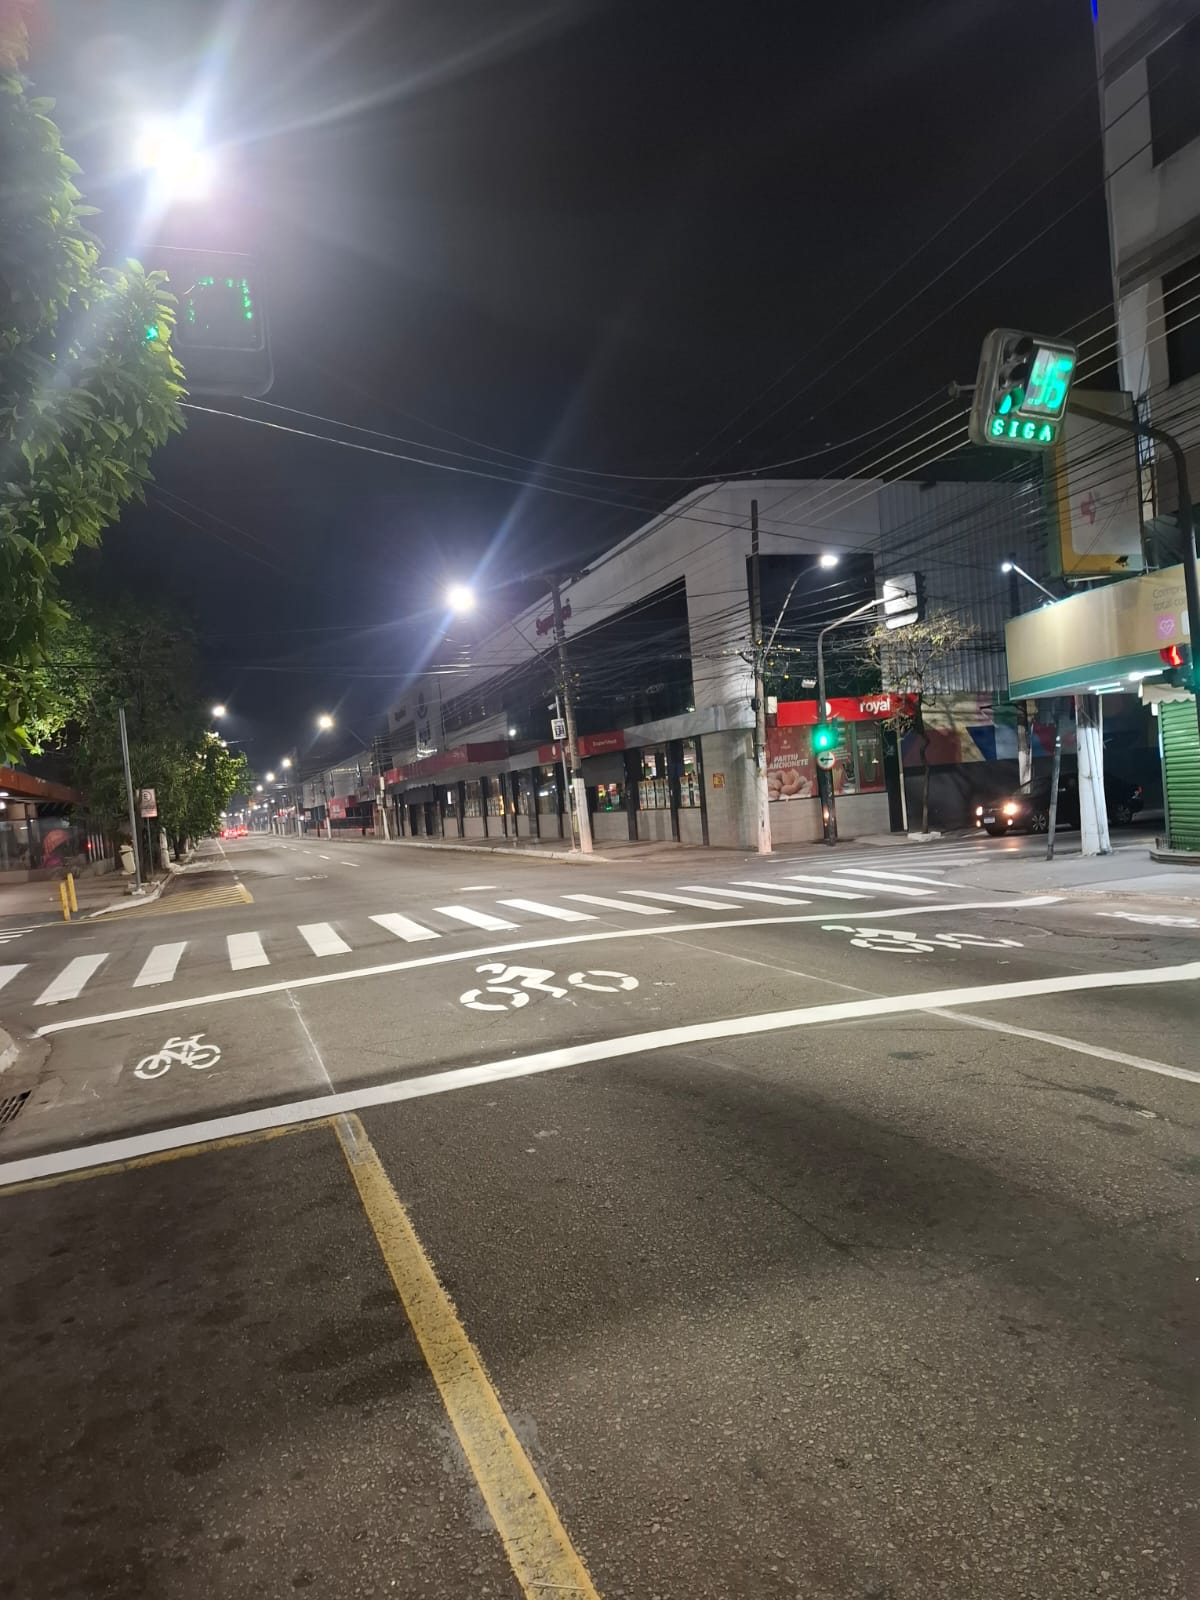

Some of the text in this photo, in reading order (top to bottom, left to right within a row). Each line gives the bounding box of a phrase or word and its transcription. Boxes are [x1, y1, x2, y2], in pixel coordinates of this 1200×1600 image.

[991, 418, 1053, 442] SIGA
[860, 698, 890, 715] royal
[767, 758, 809, 770] ANCHONETE
